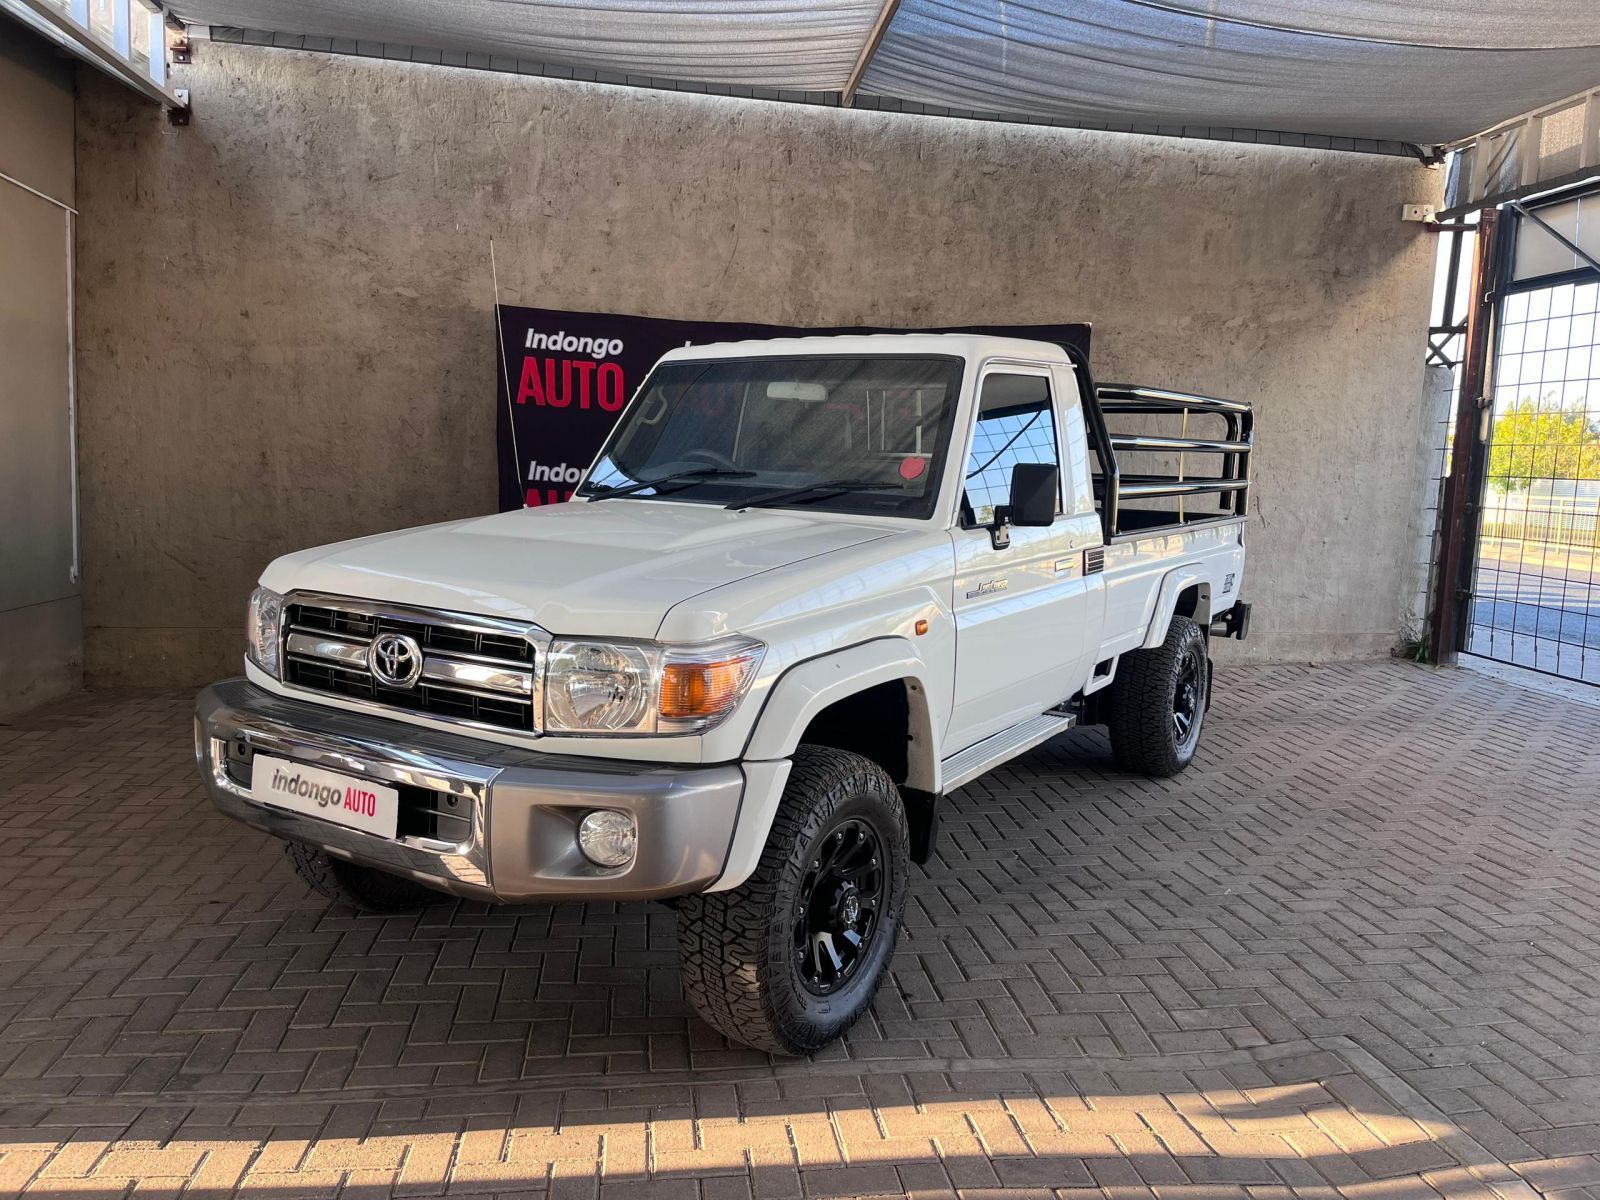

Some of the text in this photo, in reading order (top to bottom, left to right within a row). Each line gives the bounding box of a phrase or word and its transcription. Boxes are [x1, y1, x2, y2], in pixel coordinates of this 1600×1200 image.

[525, 328, 623, 358] Indongo
[517, 356, 624, 411] AUTO
[344, 787, 376, 817] AUTO
